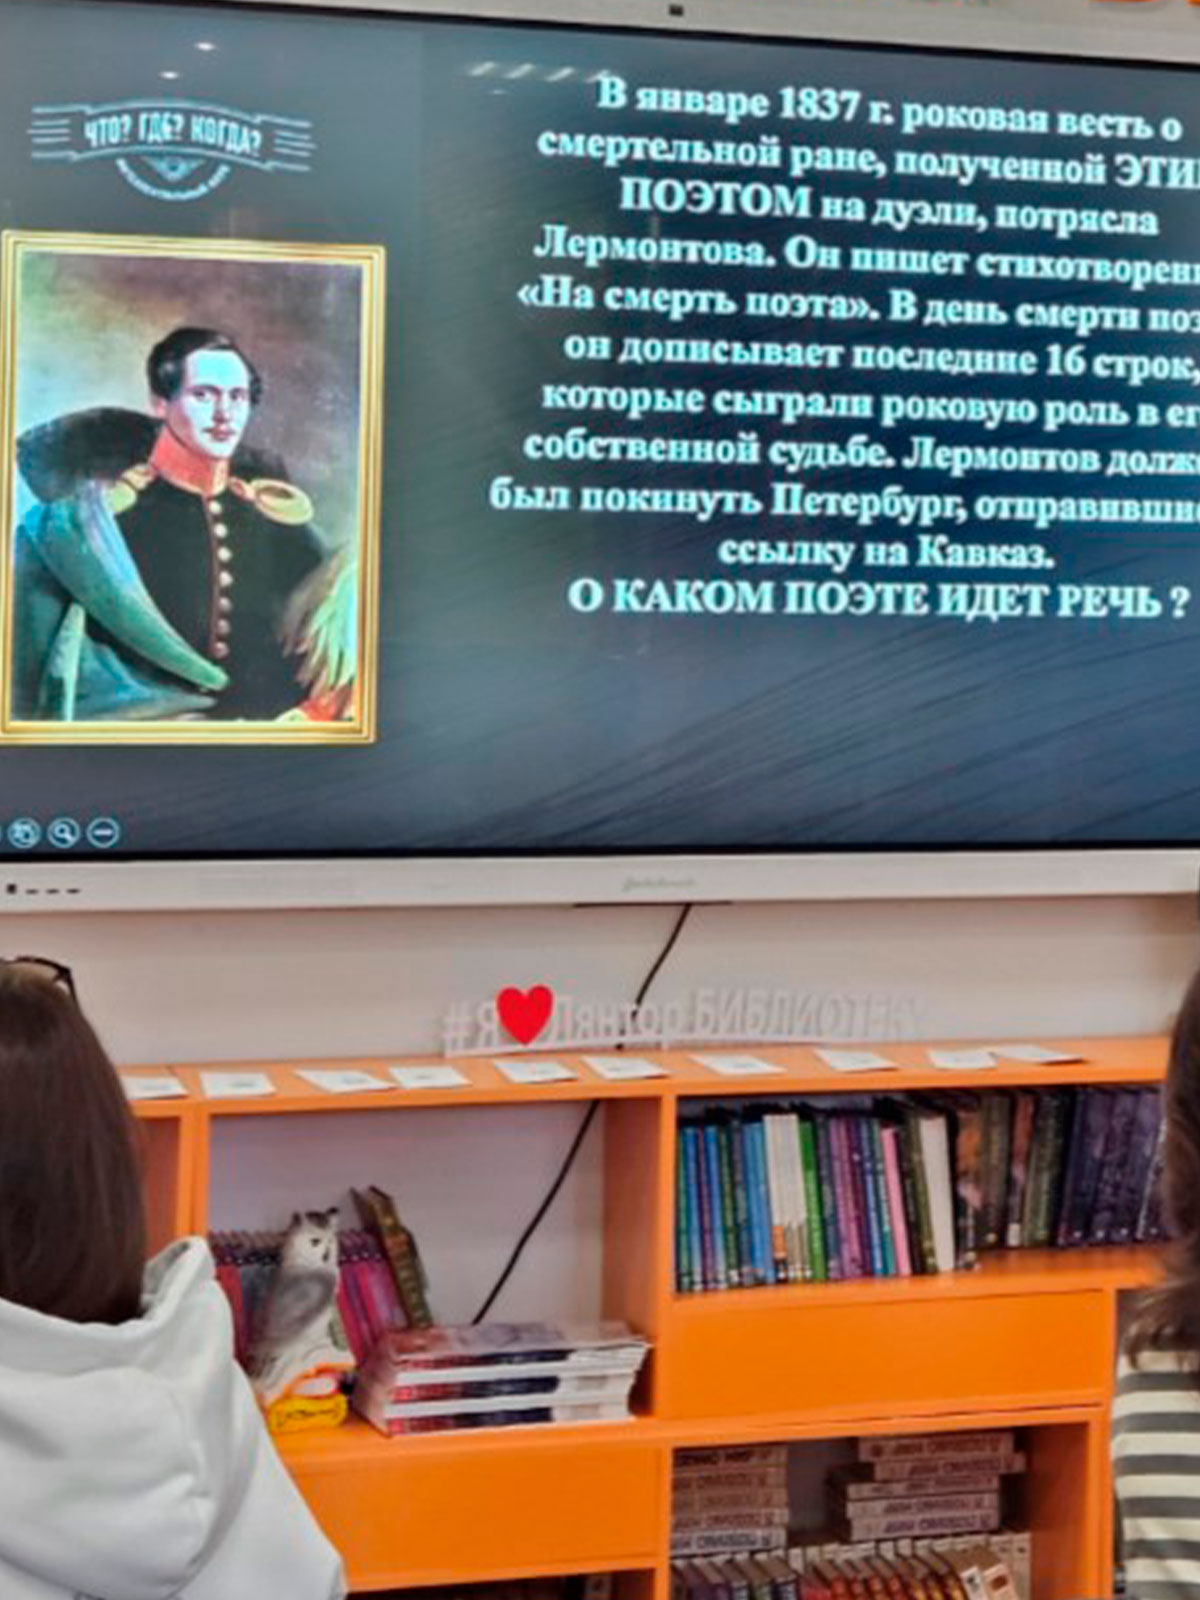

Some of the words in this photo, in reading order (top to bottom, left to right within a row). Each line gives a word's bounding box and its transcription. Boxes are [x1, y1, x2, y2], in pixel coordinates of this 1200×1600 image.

[598, 75, 627, 109] В
[636, 86, 769, 123] январе
[779, 87, 860, 120] 1837
[868, 101, 894, 124] г.
[901, 102, 1049, 134] роковая
[1057, 110, 1154, 139] весть
[1160, 118, 1183, 141] о
[84, 112, 132, 148] ЧТО?
[138, 111, 185, 144] ГДЕ?
[190, 114, 262, 157] КОГДА?
[537, 131, 780, 167] смертельной
[790, 146, 887, 177] ране,
[894, 150, 1106, 185] полученной
[619, 175, 812, 217] ПОЭТОМ
[821, 197, 866, 221] на
[871, 197, 988, 232] дуэли,
[995, 204, 1159, 240] потрясла
[532, 224, 776, 267] Лермонтова.
[785, 235, 841, 269] Он
[850, 249, 970, 273] пишет
[517, 274, 595, 310] «На
[603, 287, 735, 320] смерть
[745, 291, 880, 320] поэта».
[889, 288, 918, 320] В
[924, 299, 1008, 326] день
[1015, 301, 1141, 336] смерти
[563, 334, 612, 360] он
[617, 335, 845, 366] дописывает
[852, 344, 1038, 375] последние
[1046, 343, 1086, 376] 16
[541, 383, 705, 419] которые
[712, 388, 873, 424] сыграли
[881, 395, 1038, 429] роковую
[1043, 400, 1129, 431] роль
[1137, 403, 1160, 426] в
[523, 427, 760, 465] собственной
[768, 434, 896, 472] судьбе.
[902, 436, 1101, 477] Лермонтов
[489, 475, 571, 510] был
[579, 486, 763, 521] покинуть
[770, 482, 968, 525] Петербург,
[718, 538, 854, 573] ссылку
[863, 541, 909, 567] на
[916, 534, 1056, 568] Кавказ.
[568, 577, 604, 612] О
[612, 578, 773, 614] КАКОМ
[782, 579, 929, 616] ПОЭТЕ
[938, 581, 1050, 622] ИДЕТ
[1057, 583, 1162, 619] РЕЧЬ
